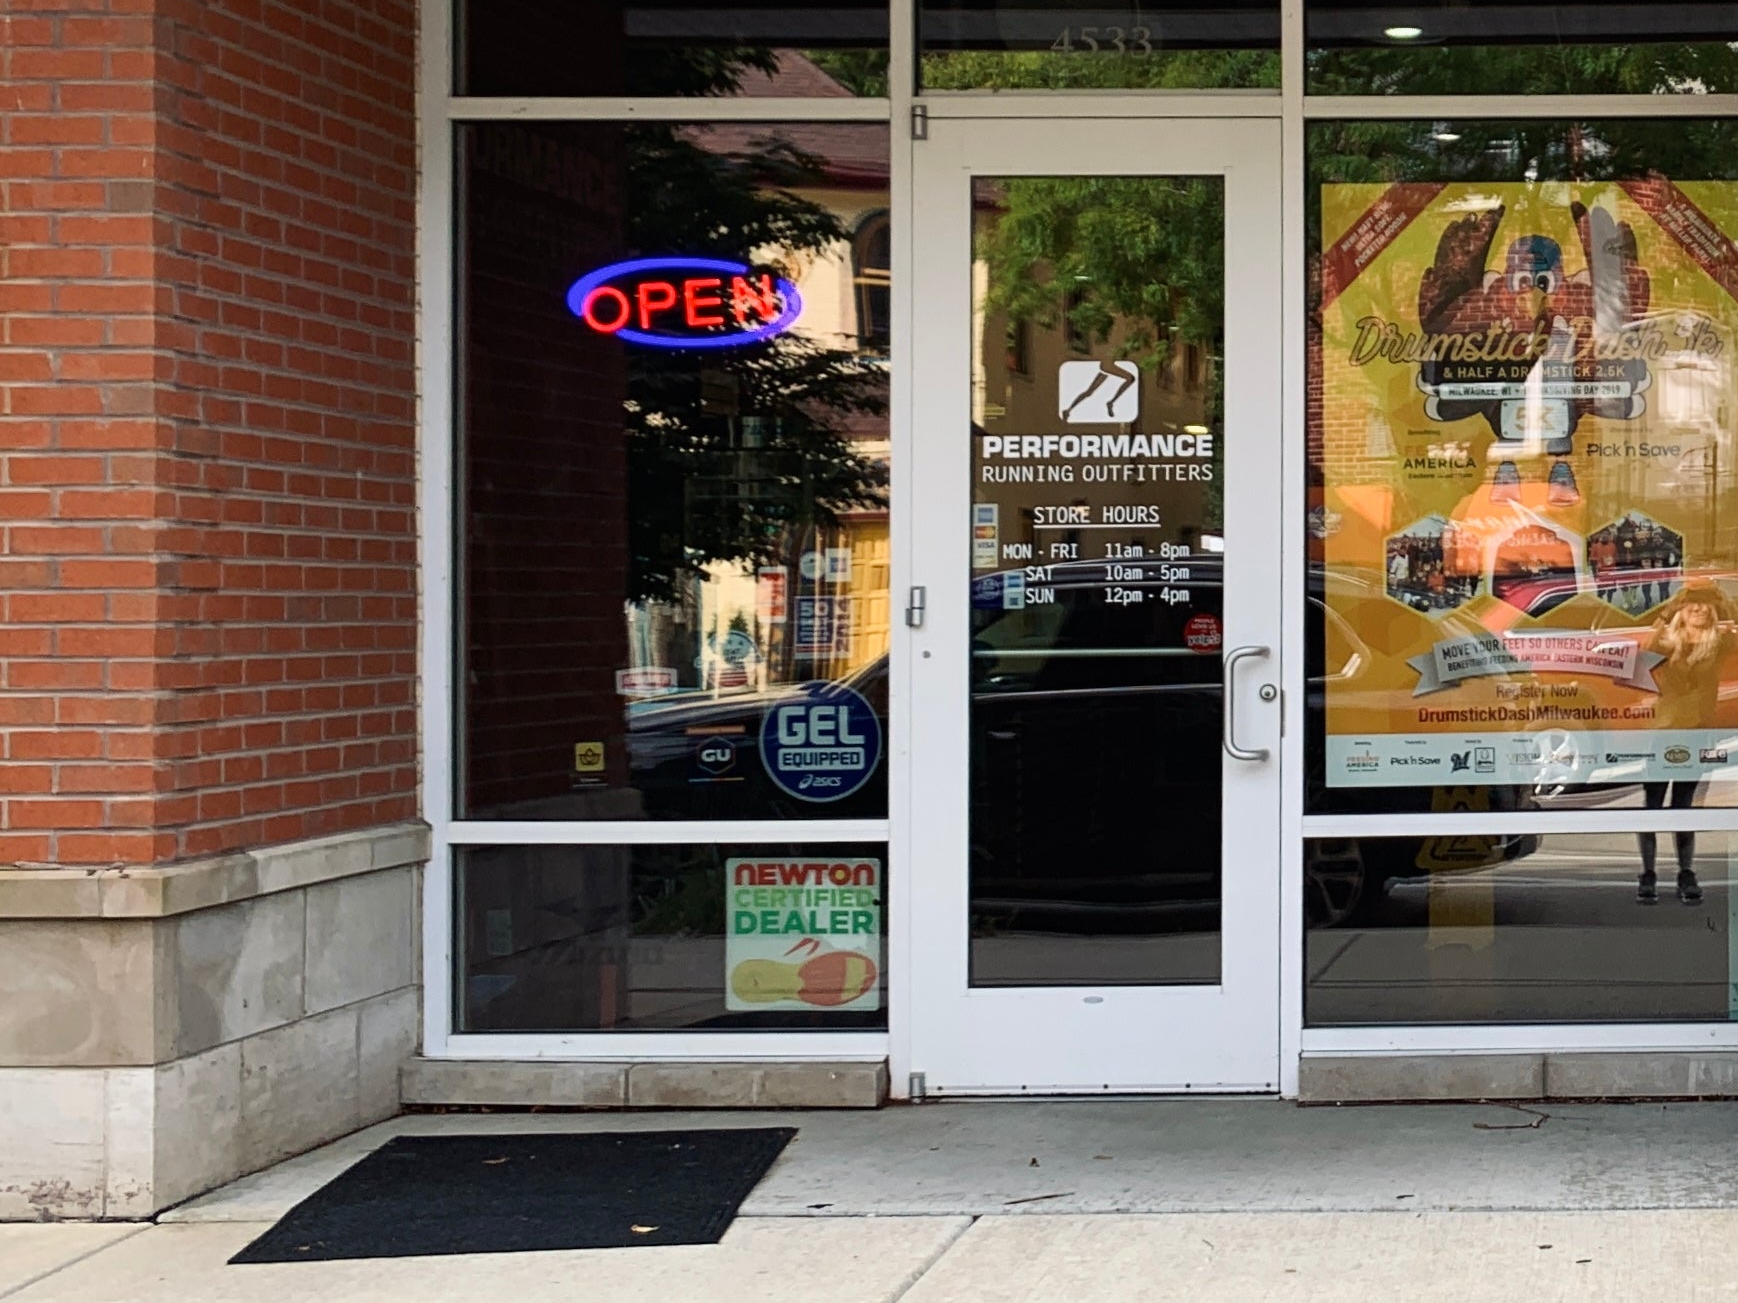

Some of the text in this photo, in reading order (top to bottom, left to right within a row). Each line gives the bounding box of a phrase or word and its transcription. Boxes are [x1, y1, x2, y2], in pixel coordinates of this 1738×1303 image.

[1050, 25, 1153, 59] 4533
[582, 275, 774, 335] OPEN
[1349, 315, 1551, 366] Drumstick
[1457, 366, 1493, 379] HALF
[1497, 366, 1507, 379] A
[1511, 366, 1592, 379] DRMSTICK
[982, 433, 1214, 459] PERFORMANCE
[1639, 442, 1681, 457] Save
[981, 462, 1214, 483] RUNNING OUTFITTERS
[1403, 458, 1477, 469] AMERICA
[1033, 505, 1160, 524] STORE HOURS
[1002, 543, 1032, 559] MON
[1050, 543, 1079, 559] FRI
[1104, 542, 1143, 558] 11am
[1160, 541, 1190, 561] 8pm
[1025, 565, 1055, 581] SAT
[1104, 564, 1143, 581] 10am
[1160, 564, 1190, 584] 5pm
[1025, 587, 1056, 604] SUN
[1104, 587, 1143, 607] 12pm
[1160, 586, 1190, 606] 4pm
[1442, 645, 1474, 660] MOVE
[1502, 637, 1526, 650] FEET
[1529, 637, 1542, 648] SO
[1545, 637, 1583, 651] OTHERS
[1496, 684, 1578, 701] Register Now
[1418, 706, 1656, 724] DrumstickDashMilwaukee.com
[777, 705, 866, 746] GEL
[700, 749, 731, 762] GU
[782, 751, 861, 767] EQUIPPED
[735, 888, 874, 909] CERTIFIED
[734, 910, 874, 935] DEALER
